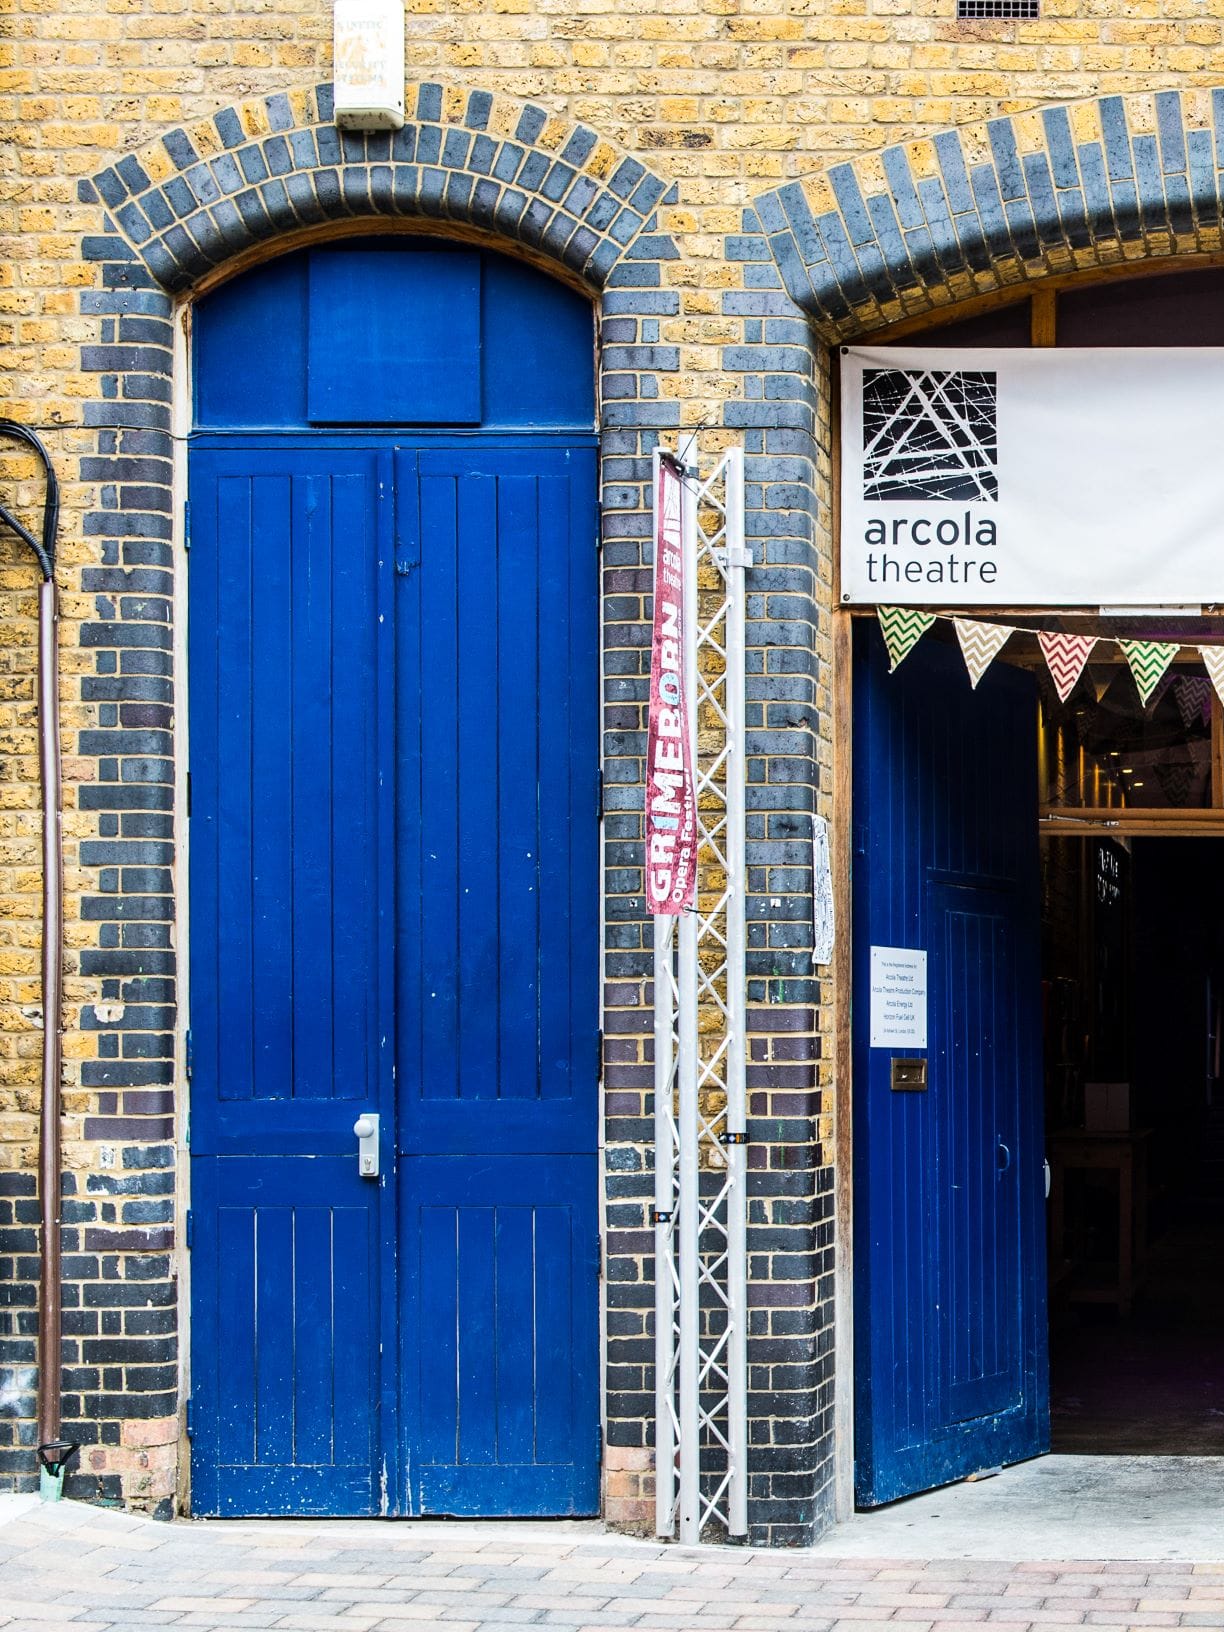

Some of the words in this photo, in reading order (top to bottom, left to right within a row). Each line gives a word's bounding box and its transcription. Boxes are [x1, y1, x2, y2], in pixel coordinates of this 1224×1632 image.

[864, 511, 997, 546] arcola
[866, 553, 998, 584] theatre
[651, 601, 684, 902] GRIMEBORN
[672, 848, 691, 903] Opera
